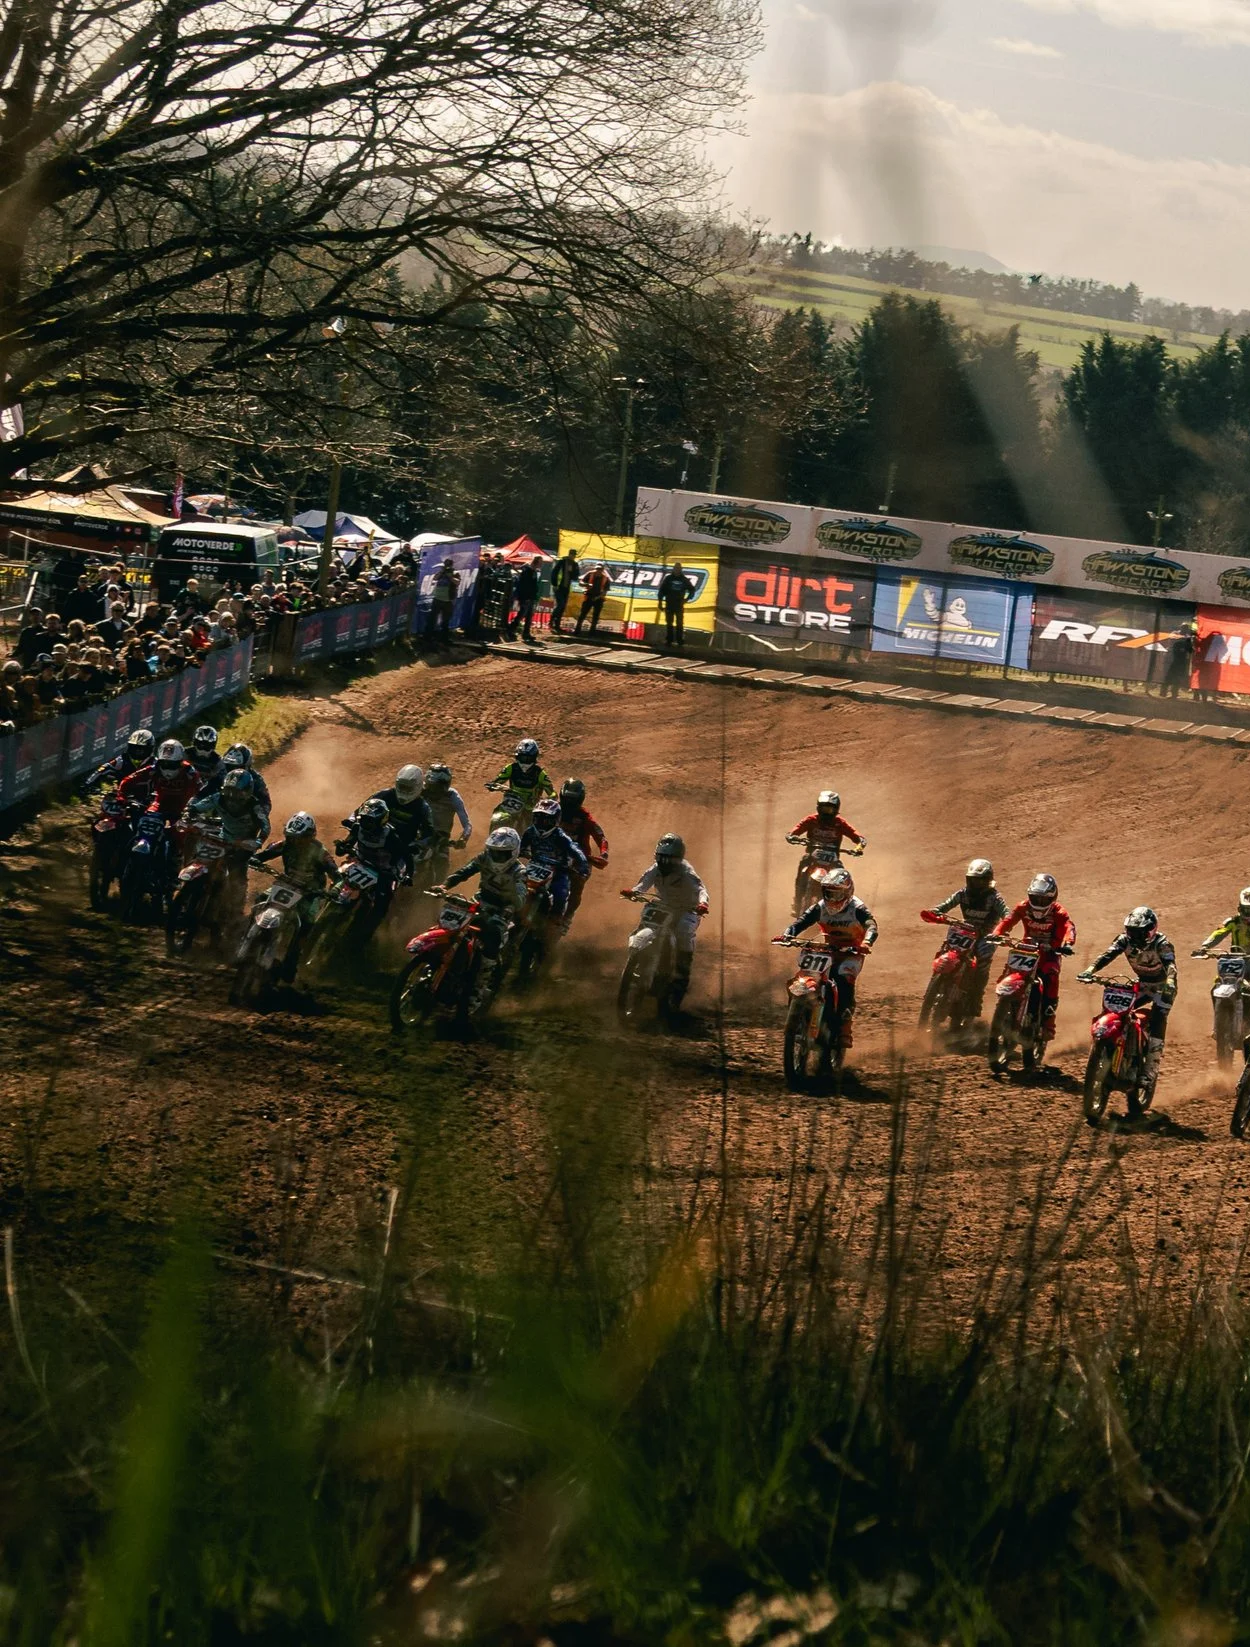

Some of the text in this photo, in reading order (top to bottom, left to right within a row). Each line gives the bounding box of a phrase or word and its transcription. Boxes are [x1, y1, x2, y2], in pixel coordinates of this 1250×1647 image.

[172, 538, 235, 551] MOTOVERDE
[736, 565, 853, 613] dirt
[733, 603, 851, 634] STORE
[902, 626, 999, 650] MICHELIN
[349, 867, 375, 888] 711
[948, 933, 974, 949] 50
[800, 954, 829, 971] 811
[1009, 955, 1036, 969] 714
[1104, 993, 1131, 1008] 426
